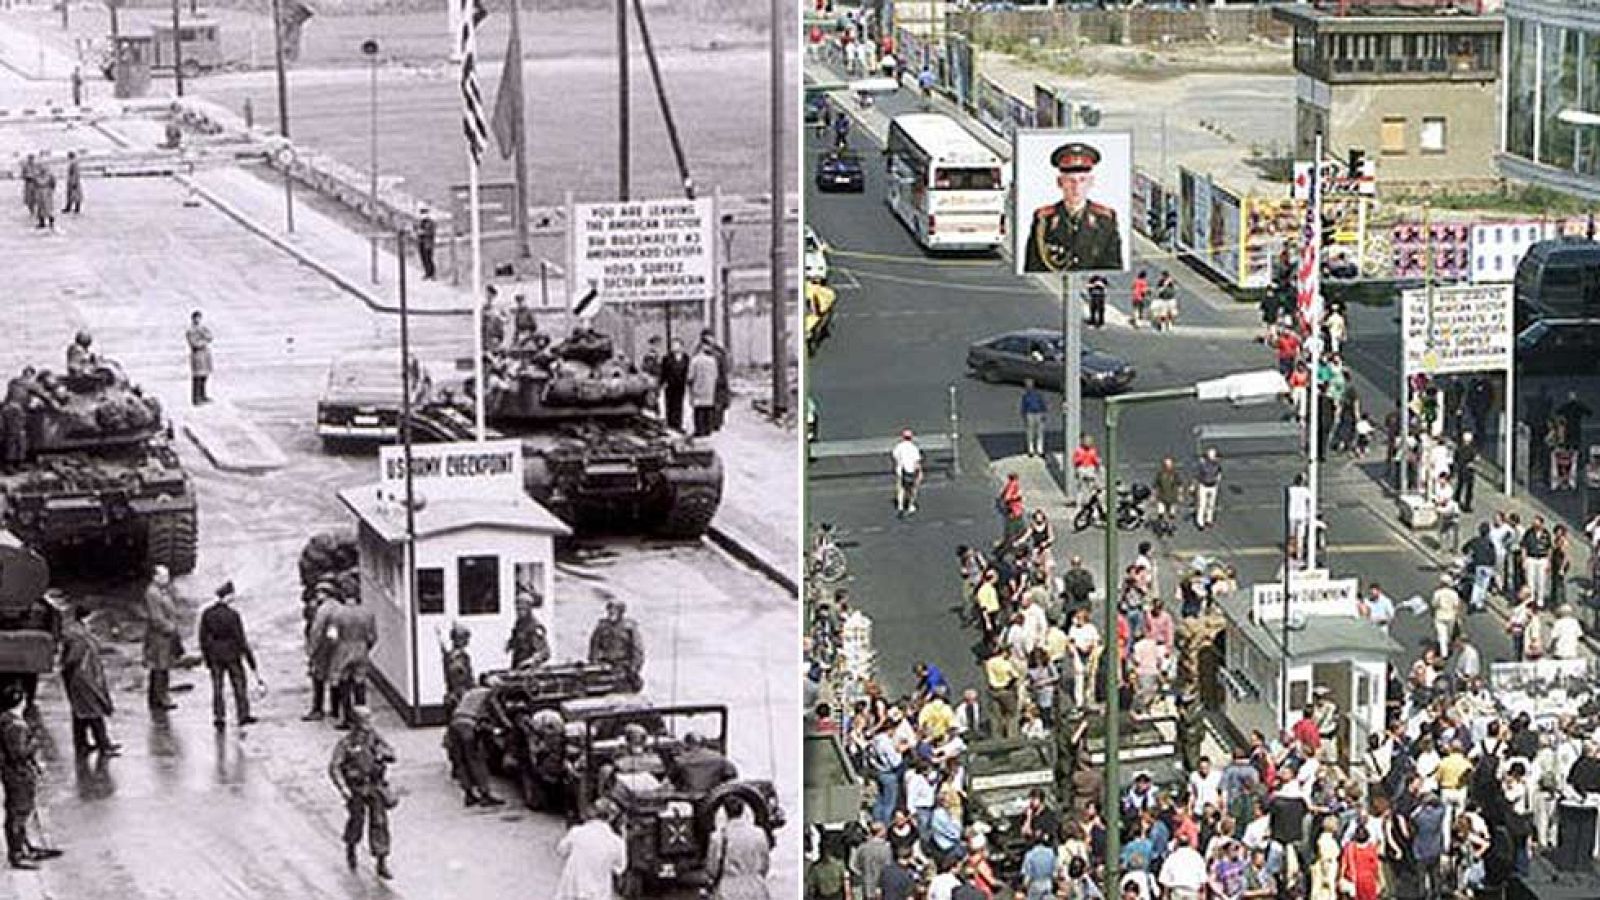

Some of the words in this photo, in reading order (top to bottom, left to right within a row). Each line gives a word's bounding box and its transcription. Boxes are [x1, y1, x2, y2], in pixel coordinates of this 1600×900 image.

[592, 206, 614, 218] YOU
[621, 206, 642, 216] ARE
[649, 204, 695, 216] LEAVING
[586, 220, 603, 230] THE
[608, 219, 659, 230] AMERICAN
[664, 218, 701, 229] SECTOR
[604, 263, 635, 275] VOUS
[640, 262, 684, 273] SORTEZ
[445, 452, 514, 477] CHECKPOINT
